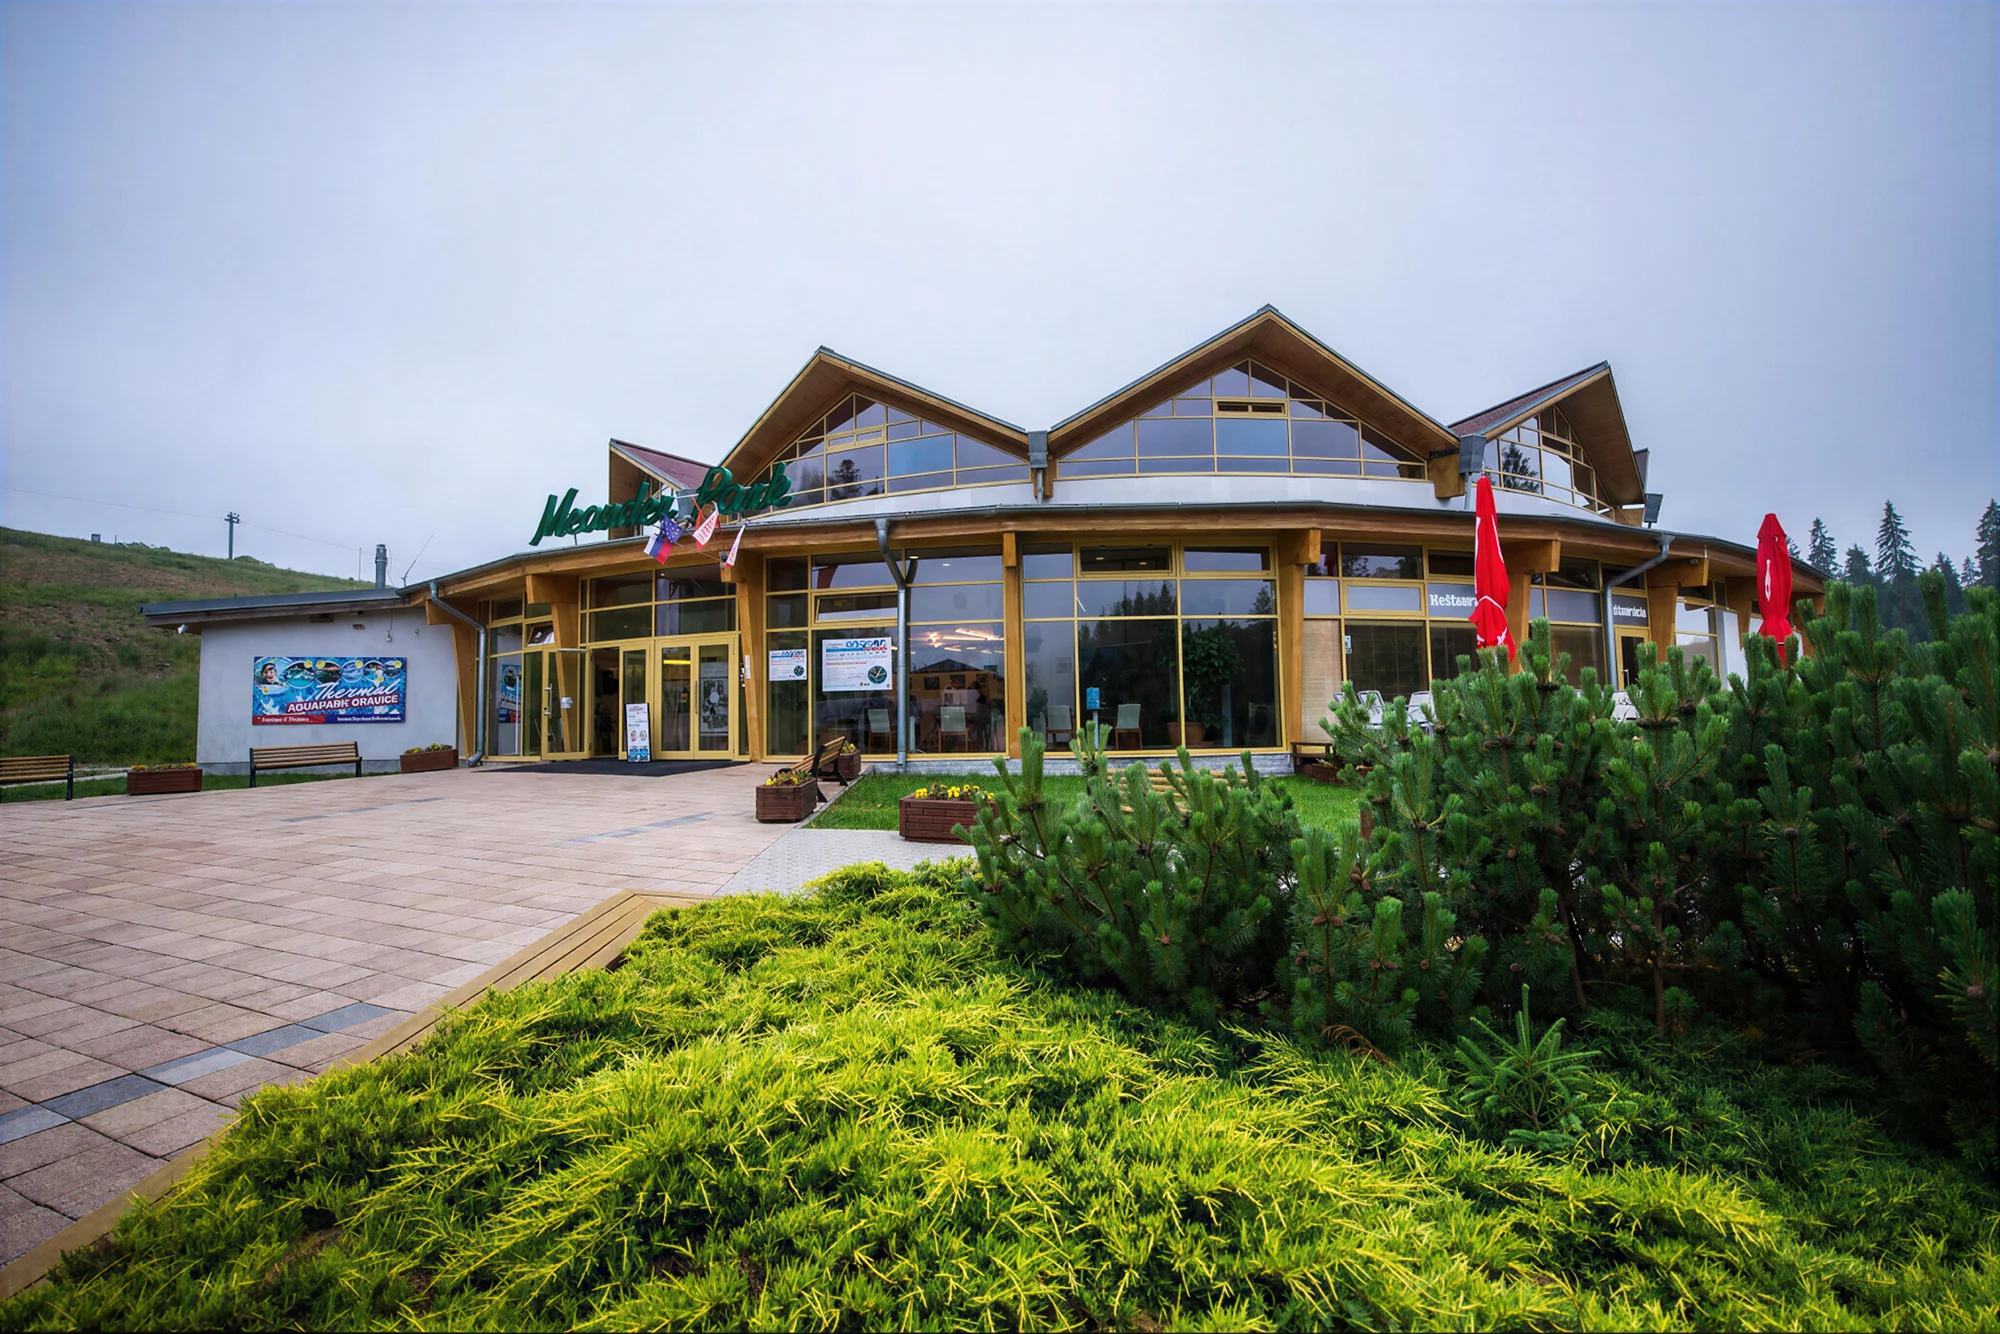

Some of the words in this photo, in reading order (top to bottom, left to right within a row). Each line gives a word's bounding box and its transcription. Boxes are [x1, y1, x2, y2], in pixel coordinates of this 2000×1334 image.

[529, 481, 678, 546] Meander
[690, 462, 795, 519] Park
[315, 678, 401, 701] Thermal
[287, 699, 349, 713] AQUAPARK
[351, 694, 399, 707] ORAVICE
